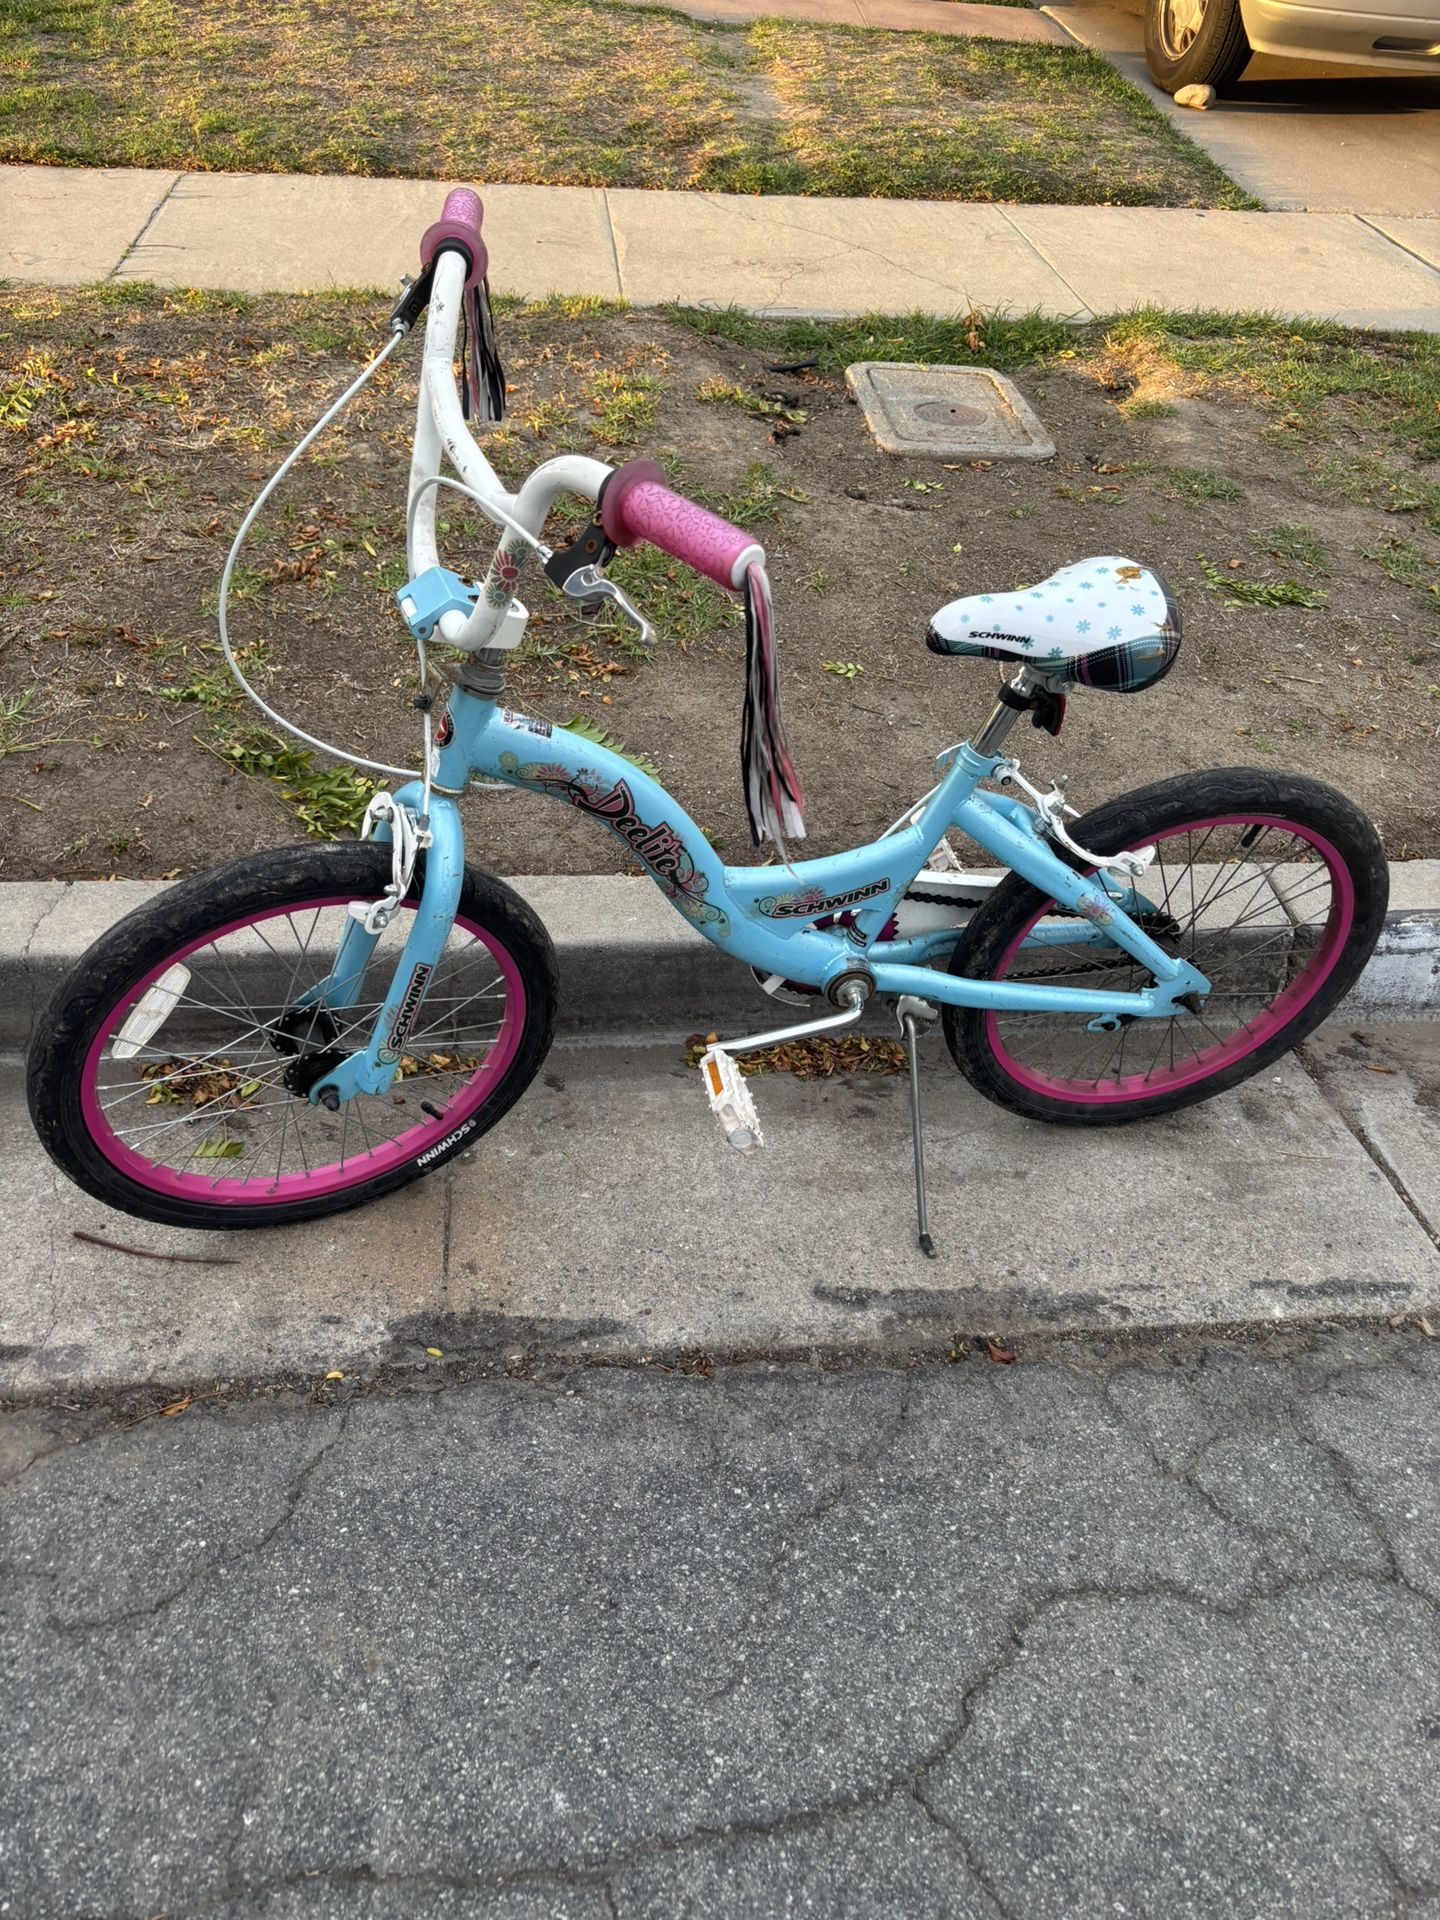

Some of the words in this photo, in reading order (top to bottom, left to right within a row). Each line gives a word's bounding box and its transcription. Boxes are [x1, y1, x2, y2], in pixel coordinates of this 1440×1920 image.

[968, 631, 1030, 644] SCHWINN
[573, 779, 680, 876] Deelite
[775, 879, 888, 916] SCHWINN
[390, 965, 430, 1050] SCHWINN
[416, 1122, 471, 1168] SCHWINN
